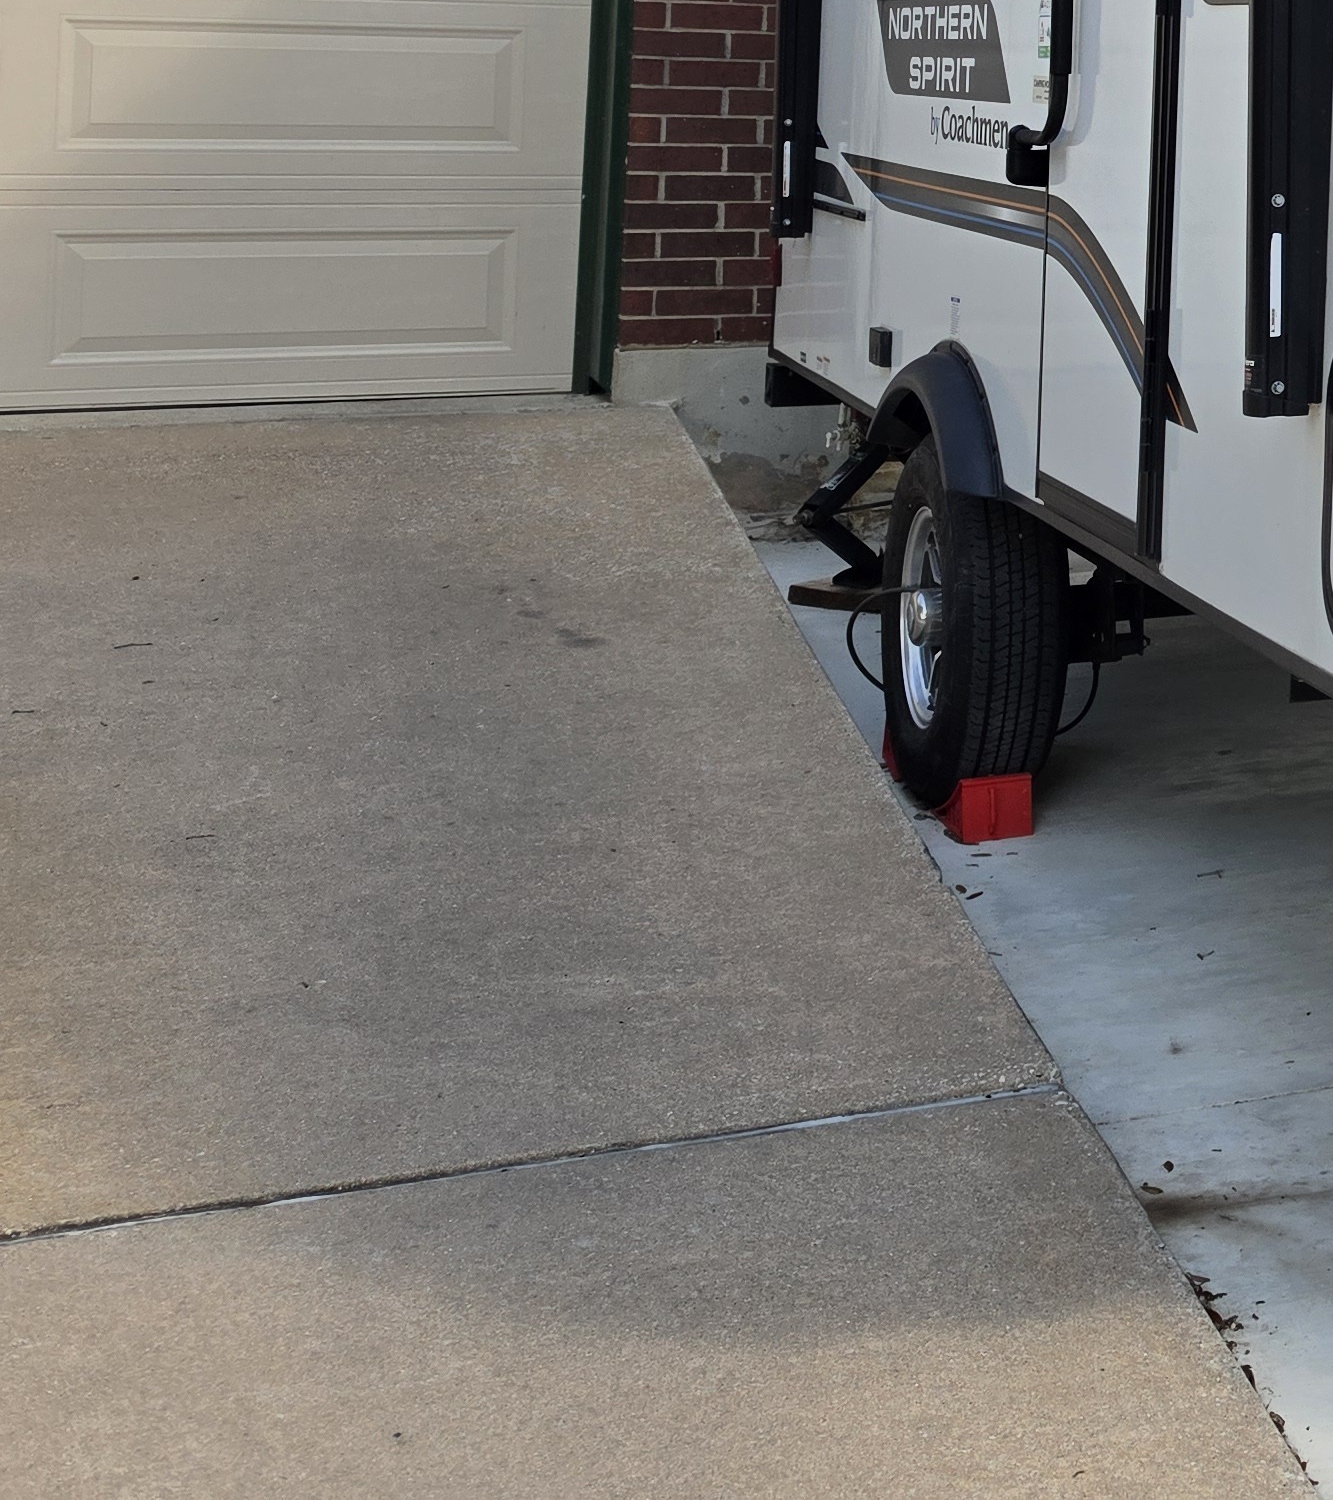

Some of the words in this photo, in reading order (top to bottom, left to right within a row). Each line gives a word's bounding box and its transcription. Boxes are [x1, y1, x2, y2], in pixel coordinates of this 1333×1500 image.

[888, 3, 988, 40] NORTHERN
[909, 56, 975, 93] SPIRIT
[930, 106, 940, 145] by
[941, 105, 1010, 150] Coachmen
